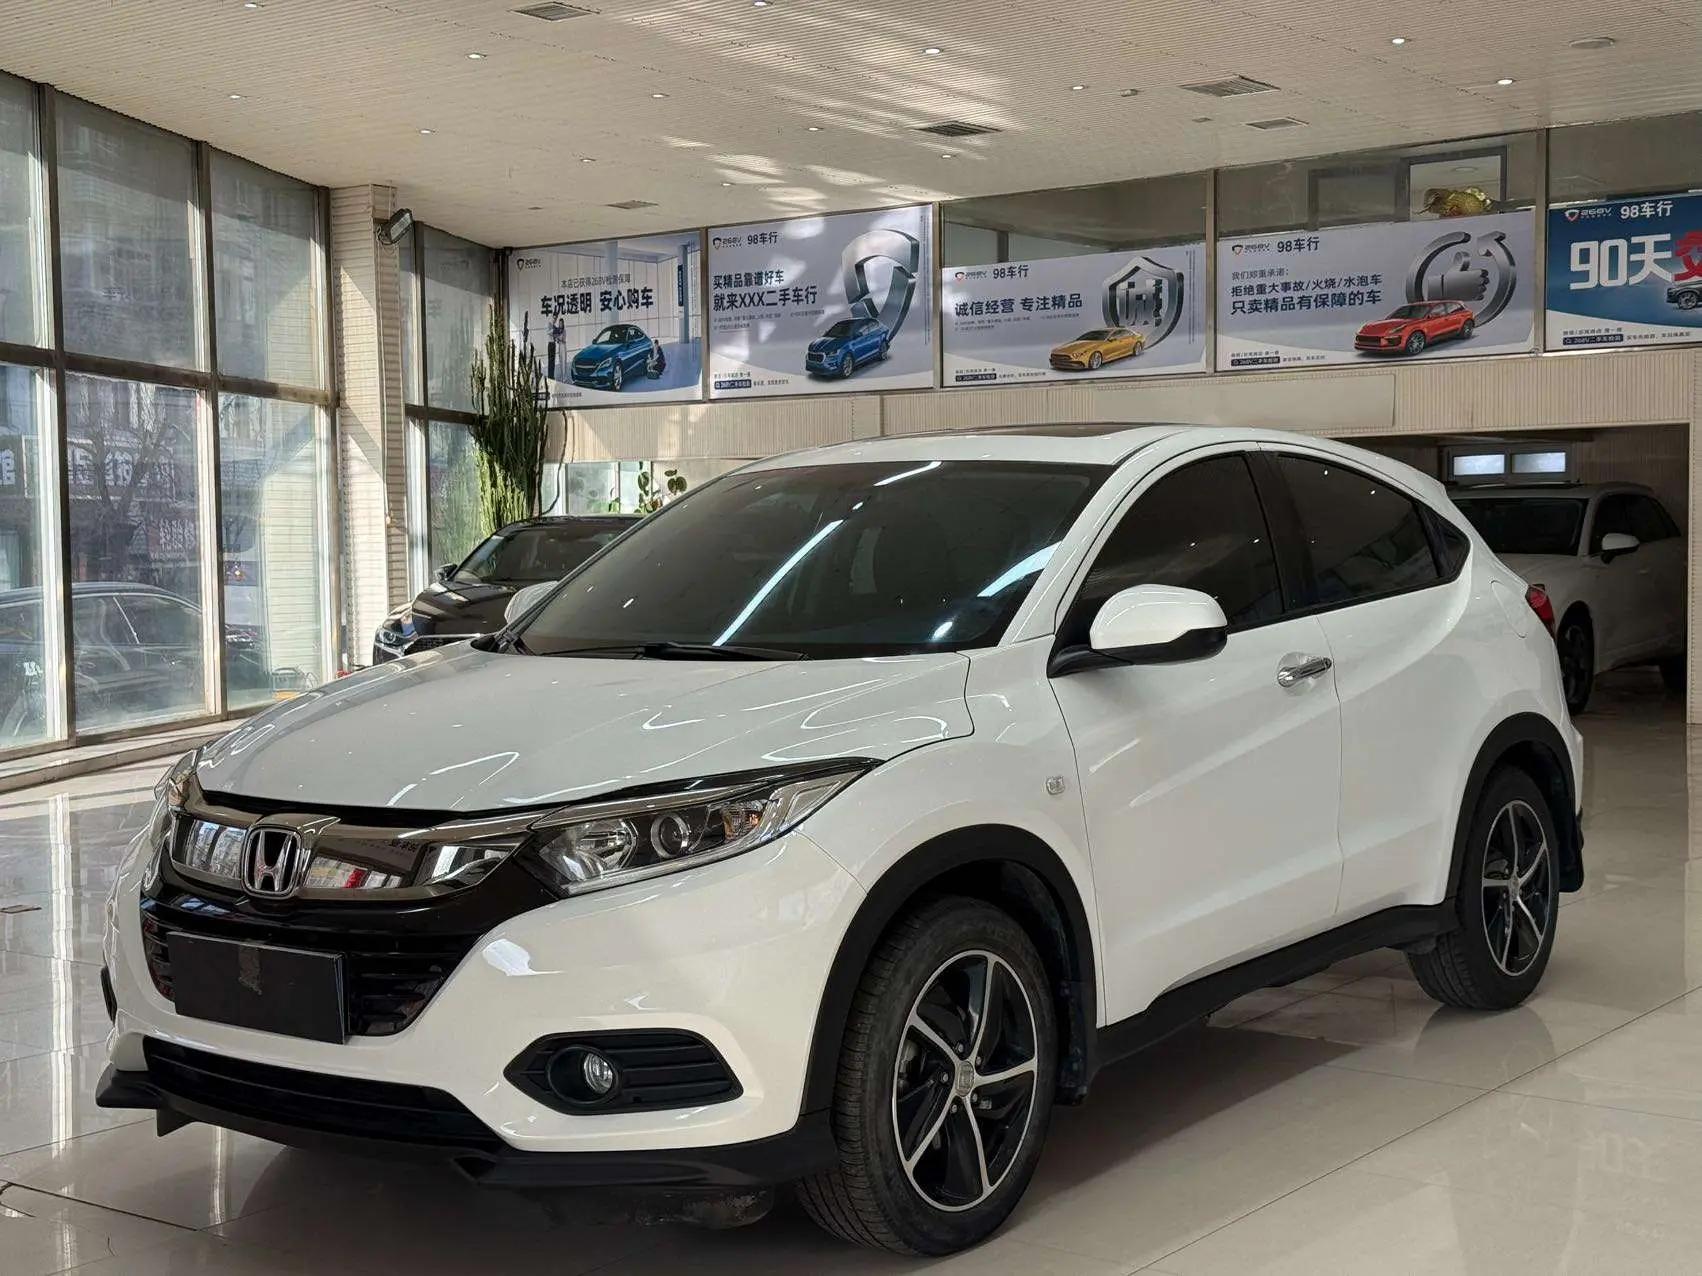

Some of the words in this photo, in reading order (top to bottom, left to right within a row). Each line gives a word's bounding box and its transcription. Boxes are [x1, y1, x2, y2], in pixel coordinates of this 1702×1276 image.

[1620, 200, 1673, 219] 98车行
[747, 231, 778, 246] 98车行
[1276, 236, 1320, 253] 98车行
[993, 264, 1029, 279] 98车行
[1569, 233, 1673, 290] 90天
[713, 269, 784, 290] 买精品靠谱好车
[1230, 273, 1382, 297] 拒绝重大事故/火烧/水泡车
[540, 292, 592, 317] 车况透明
[599, 286, 654, 313] 安心购车
[713, 285, 818, 312] 就来XXX二手车行
[954, 298, 1016, 318] 诚信经营
[1020, 293, 1083, 313] 专注精品
[1230, 290, 1382, 315] 只卖精品有保障的车
